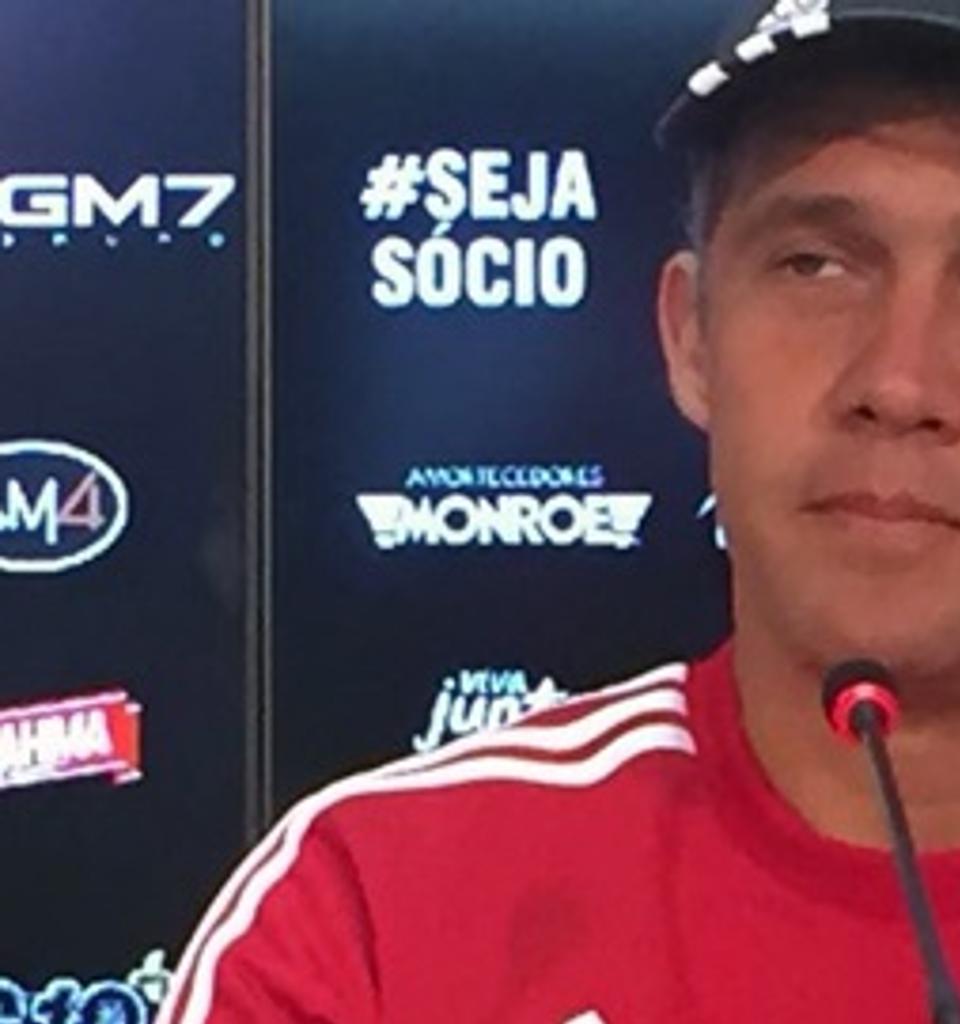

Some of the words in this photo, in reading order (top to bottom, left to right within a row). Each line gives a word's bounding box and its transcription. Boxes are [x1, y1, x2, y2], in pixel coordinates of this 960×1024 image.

[0, 173, 236, 228] GM7
[359, 147, 597, 221] #SEJA
[371, 220, 587, 309] SÓCIO
[388, 493, 622, 548] MONROE
[412, 676, 570, 752] junt
